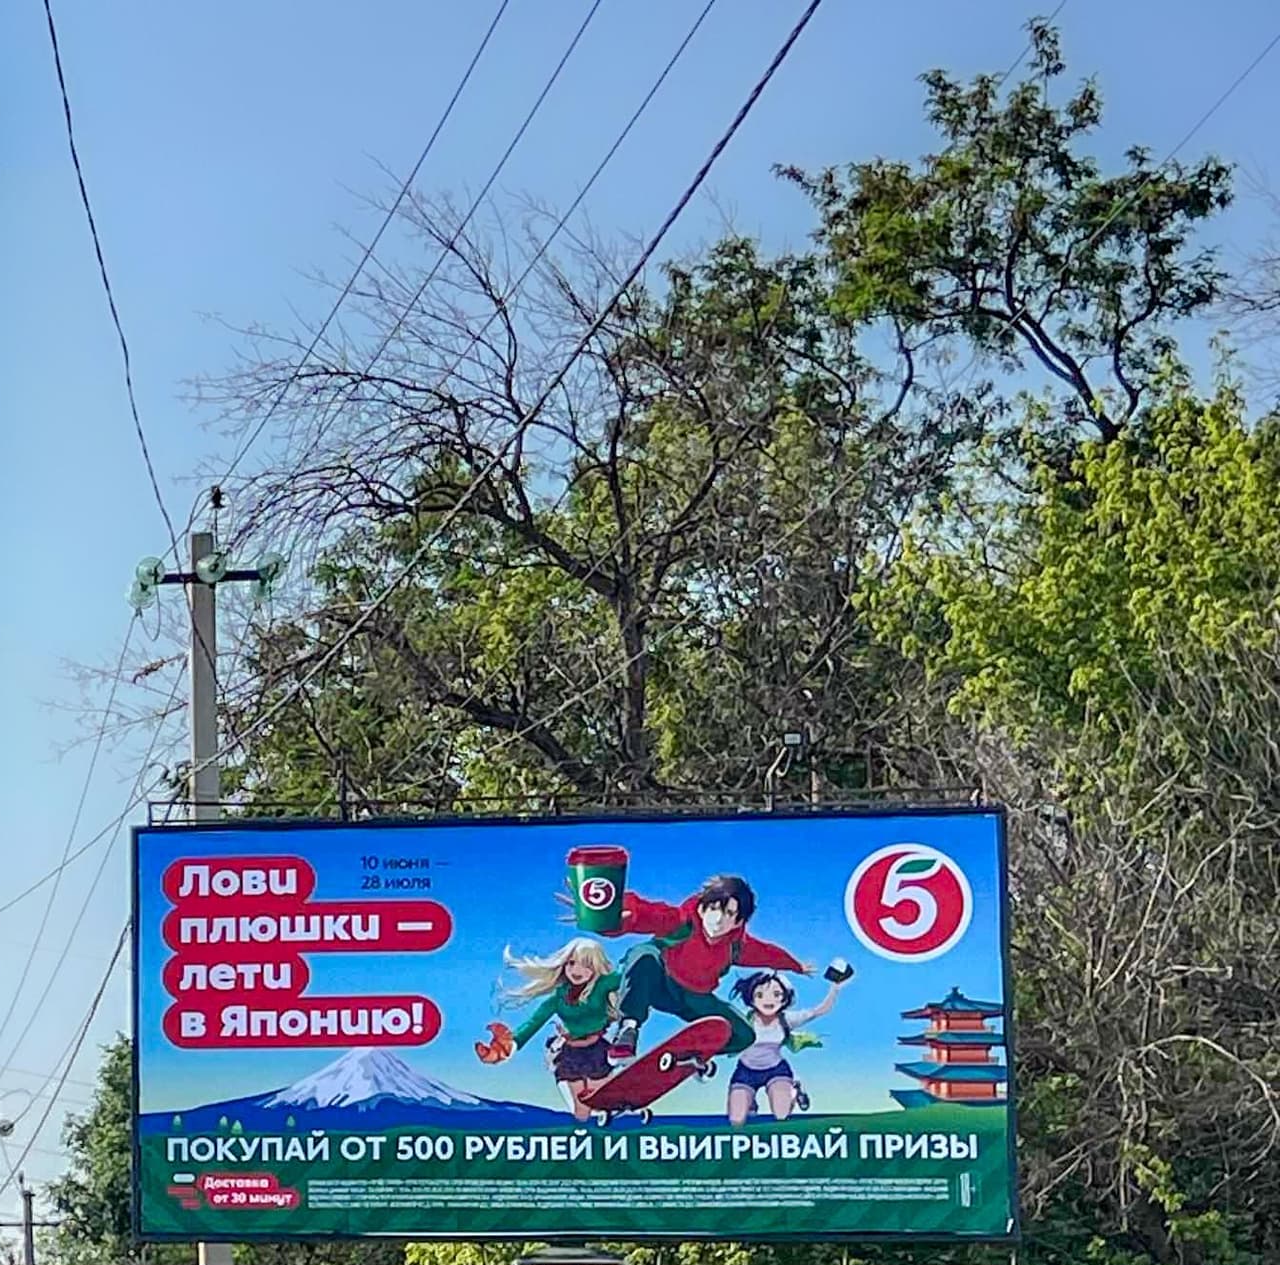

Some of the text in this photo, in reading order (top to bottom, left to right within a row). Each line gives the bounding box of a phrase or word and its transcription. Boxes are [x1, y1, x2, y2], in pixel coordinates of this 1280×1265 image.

[360, 856, 379, 869] 10
[382, 858, 430, 869] июня
[178, 865, 298, 897] Лови
[360, 875, 431, 889] 28 июля
[879, 853, 942, 940] 5
[179, 914, 380, 943] плюшки
[179, 962, 292, 990] лети
[180, 1002, 424, 1038] в Японию!
[166, 1128, 979, 1162] ПОКУПАЙ ОТ 500 РУБЛЕЙ И ВЫИГРЫВАЙ ПРИЗЫ
[204, 1176, 269, 1189] Доставка
[212, 1192, 292, 1206] от 30 минут
